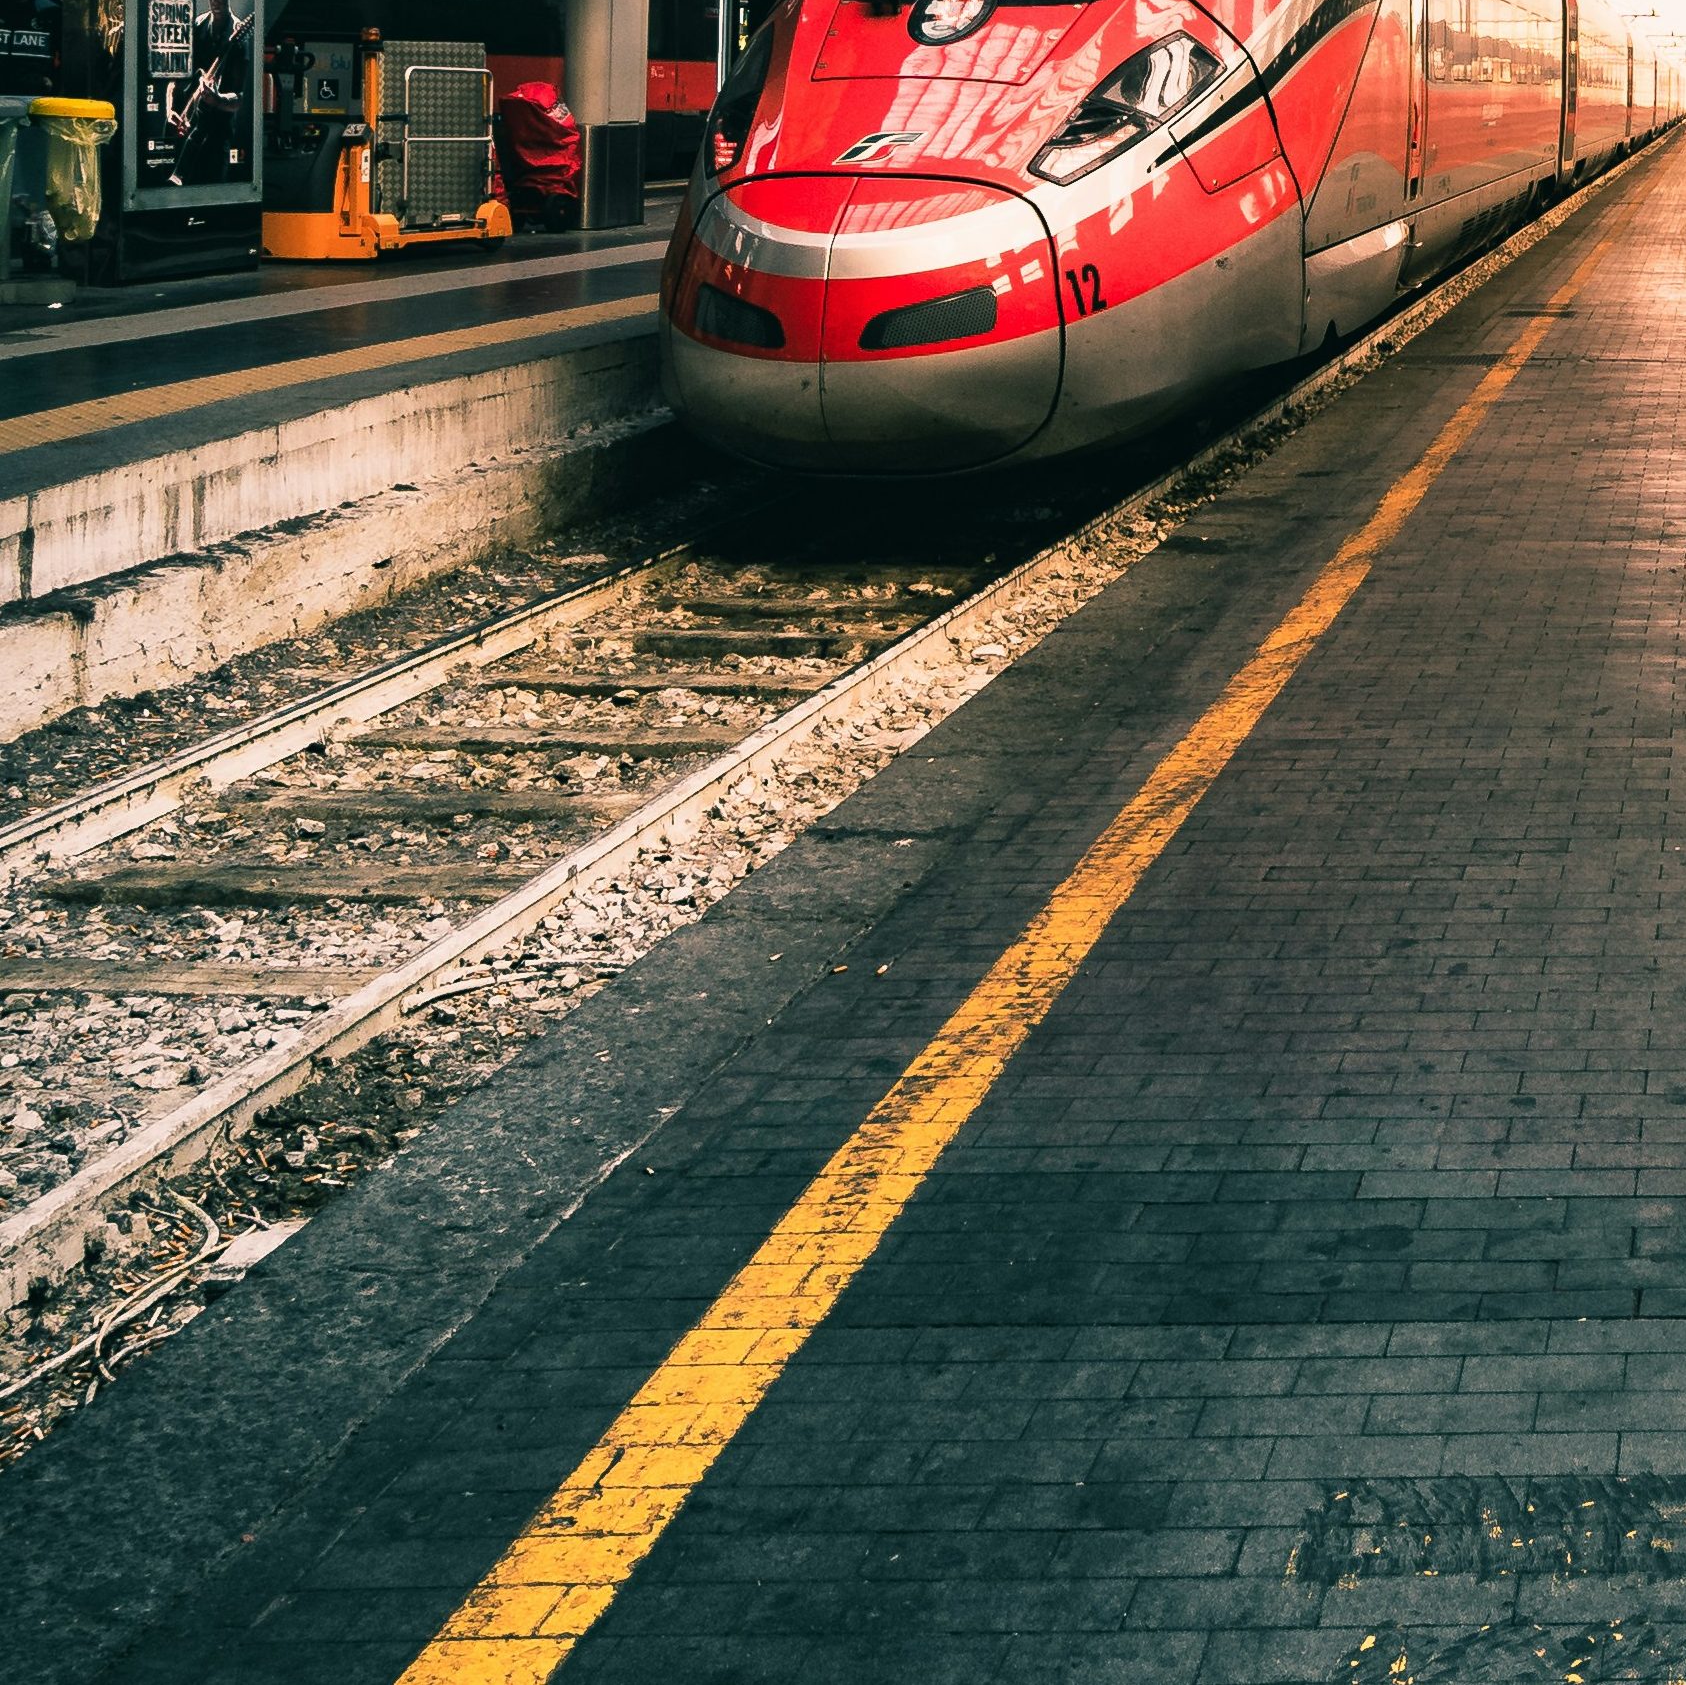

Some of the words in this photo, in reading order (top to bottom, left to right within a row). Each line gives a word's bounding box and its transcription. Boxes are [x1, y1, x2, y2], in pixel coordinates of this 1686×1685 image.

[151, 2, 191, 24] SPRING
[13, 34, 47, 47] LANE
[151, 23, 190, 44] STEEN
[1064, 263, 1108, 317] 12
